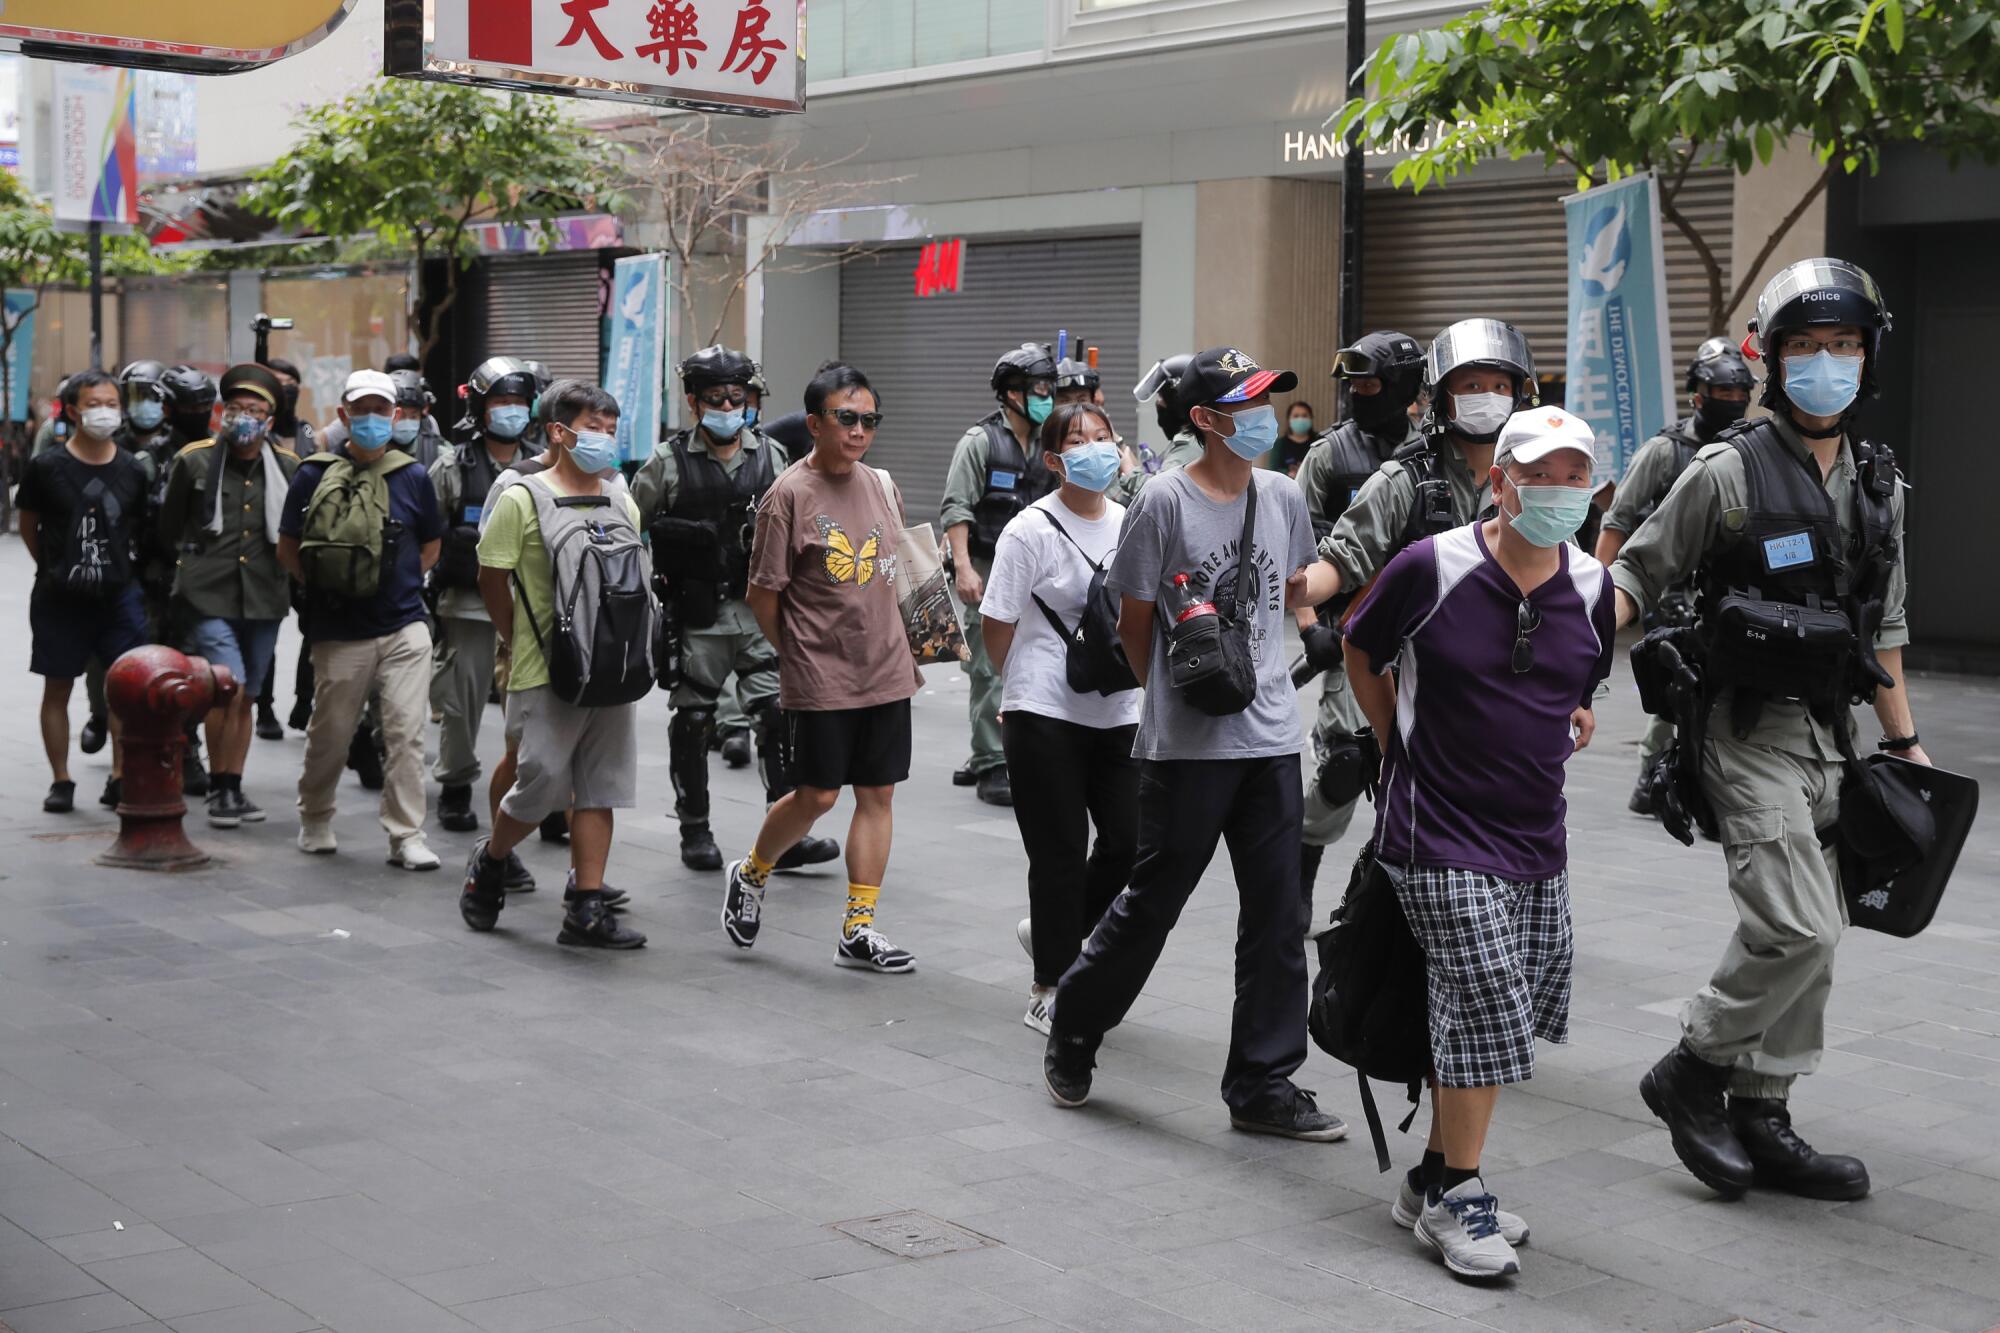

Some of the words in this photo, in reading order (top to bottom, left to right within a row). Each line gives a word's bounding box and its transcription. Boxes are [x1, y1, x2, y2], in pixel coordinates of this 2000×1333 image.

[554, 0, 788, 85] 大藥房
[913, 238, 961, 298] H&M
[1802, 291, 1841, 304] Police
[1222, 539, 1274, 571] ANNT
[1267, 570, 1280, 611] WAYS
